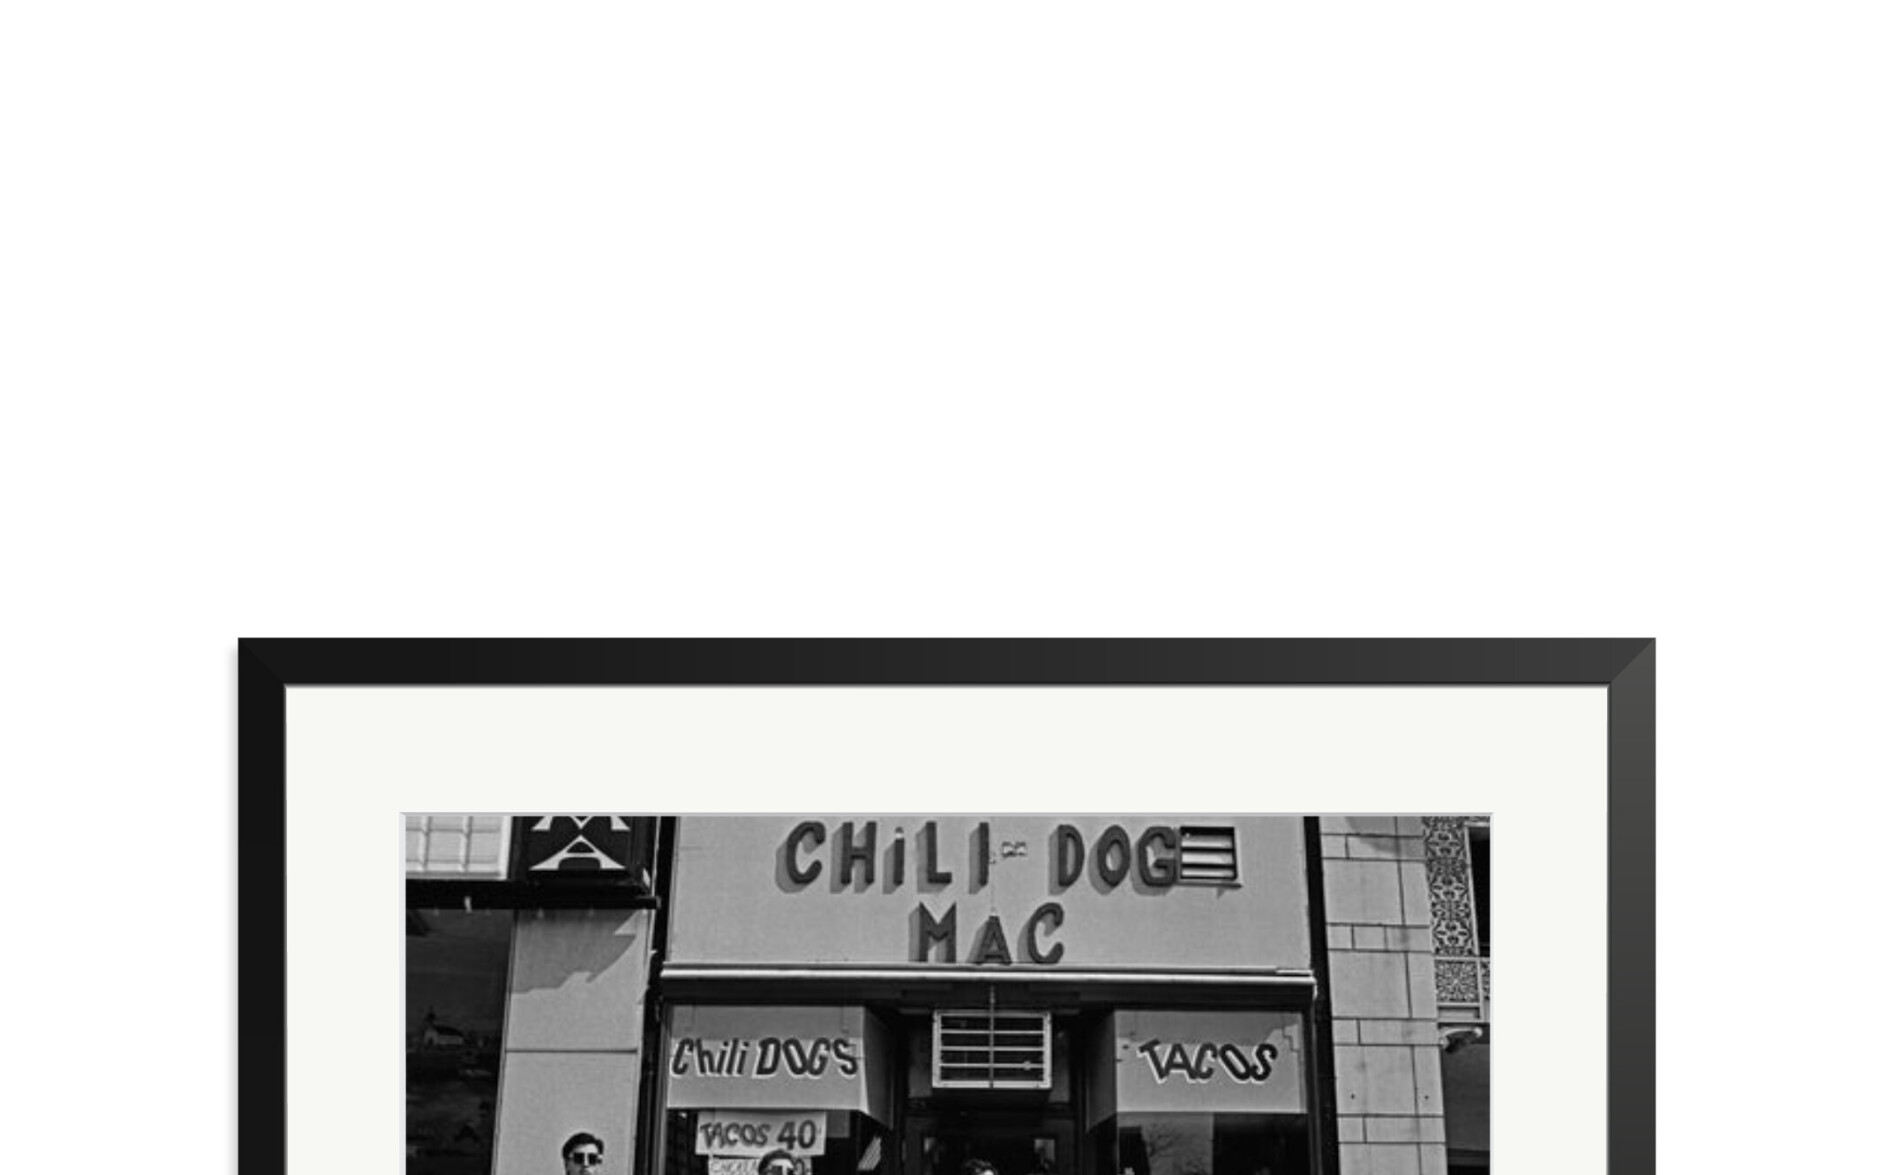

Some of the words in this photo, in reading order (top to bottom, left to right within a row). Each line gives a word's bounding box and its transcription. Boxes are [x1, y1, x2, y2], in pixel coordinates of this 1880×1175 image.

[909, 901, 1065, 964] MAC
[671, 1036, 750, 1077] Chili
[754, 1035, 859, 1079] DOGS
[1138, 1038, 1279, 1083] TACOS
[699, 1121, 772, 1149] TACOS
